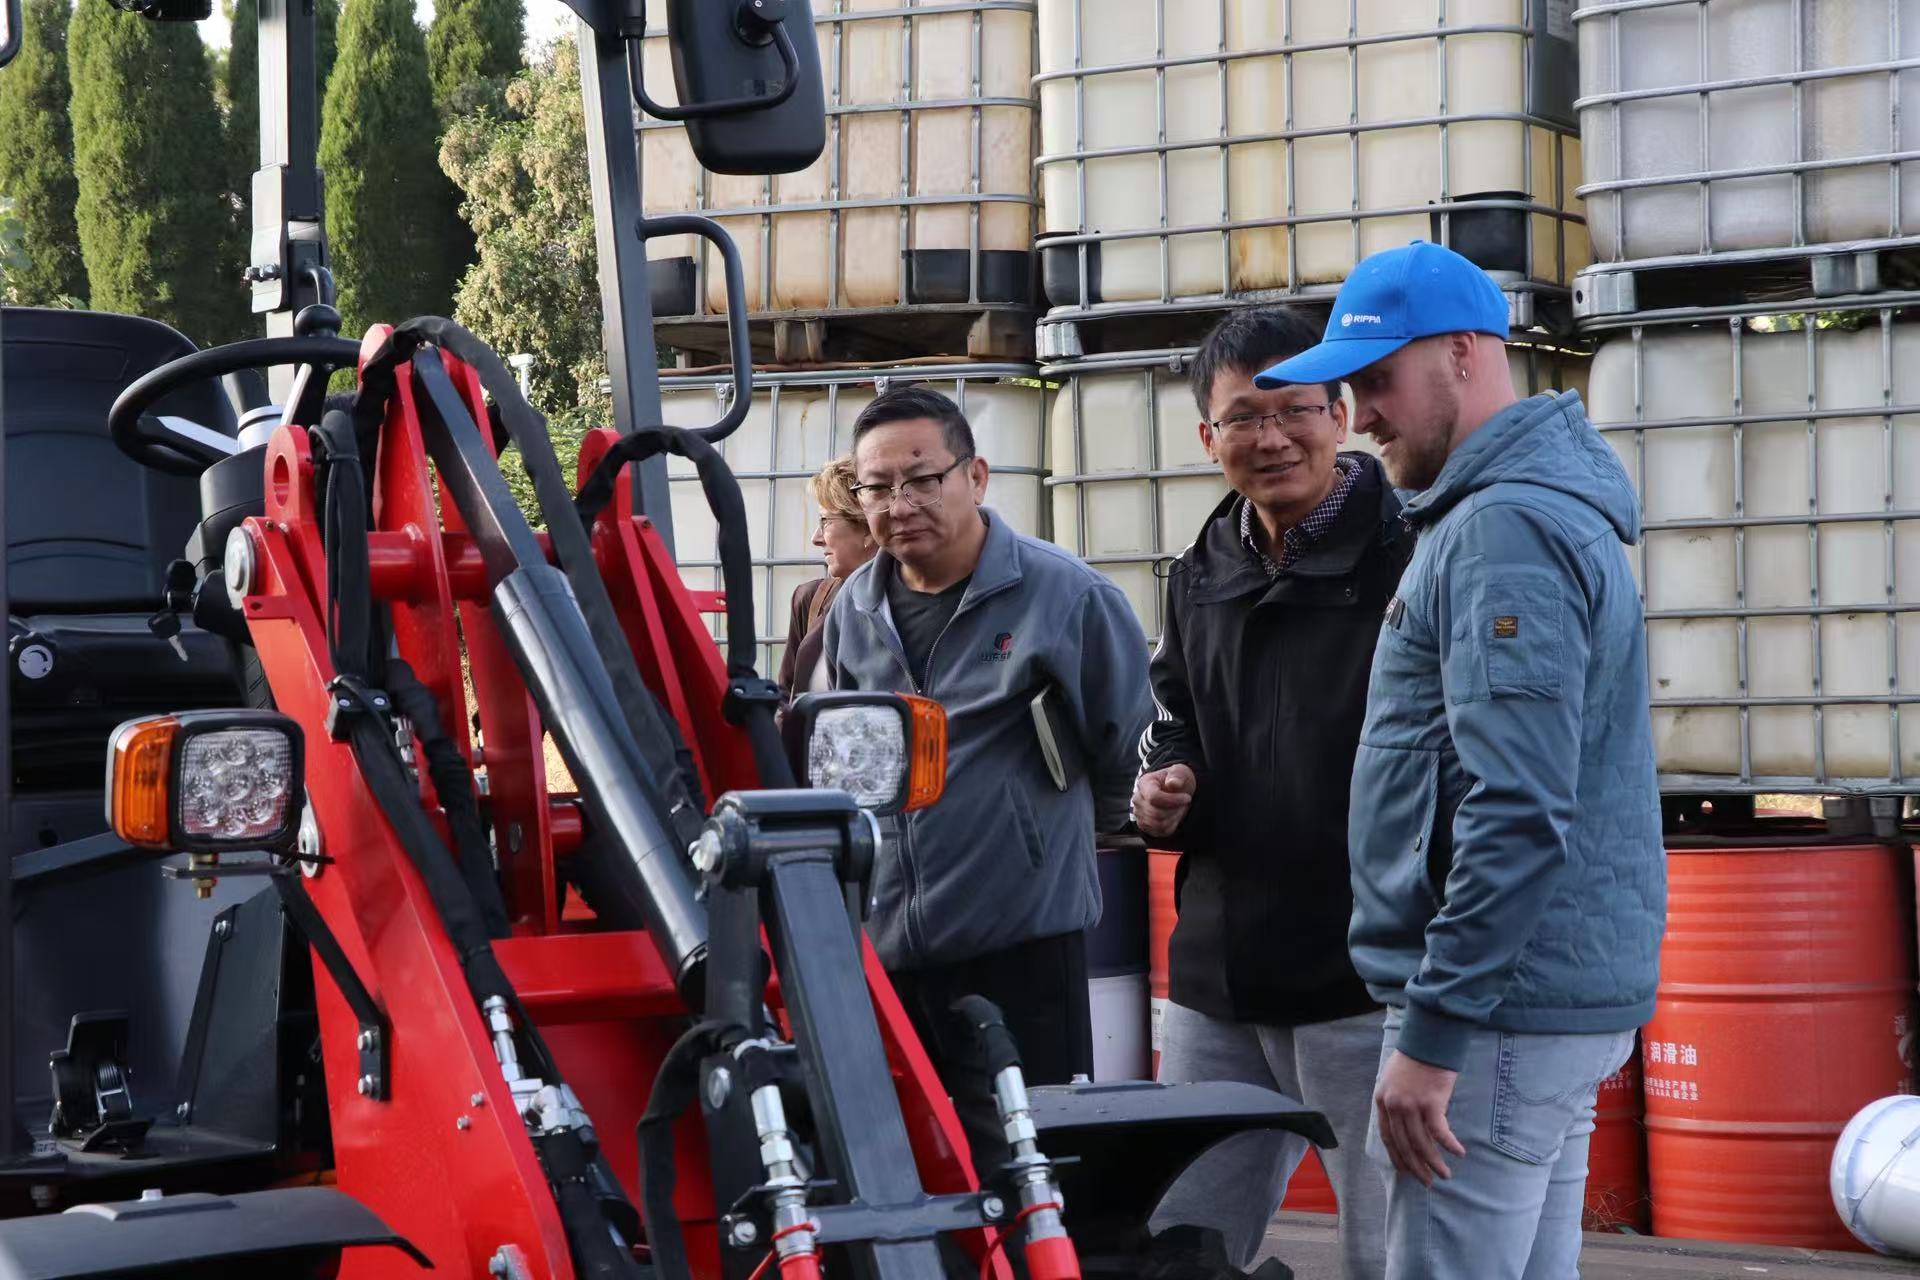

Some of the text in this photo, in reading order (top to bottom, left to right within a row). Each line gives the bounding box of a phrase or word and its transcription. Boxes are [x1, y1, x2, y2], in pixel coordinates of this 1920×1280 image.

[1353, 315, 1381, 324] RIPPA
[1650, 1041, 1697, 1067] 润滑油
